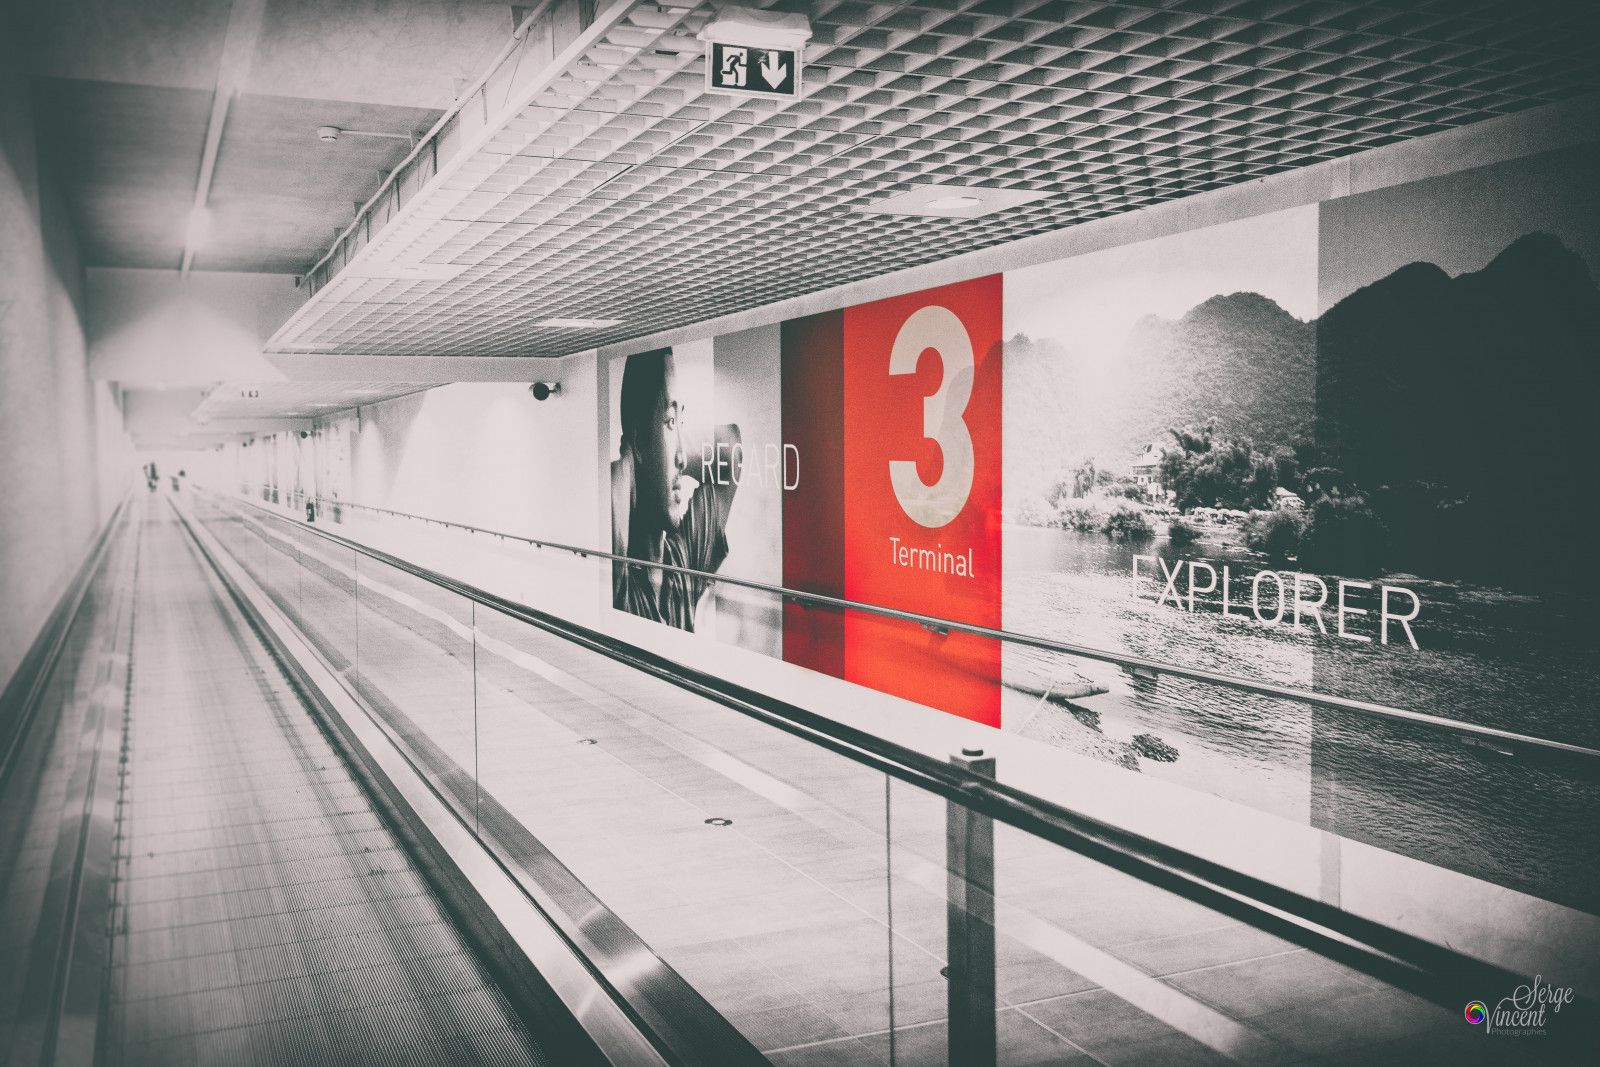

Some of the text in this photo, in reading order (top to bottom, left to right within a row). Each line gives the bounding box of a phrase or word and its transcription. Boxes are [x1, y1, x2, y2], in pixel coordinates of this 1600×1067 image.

[889, 305, 975, 529] 3
[701, 442, 800, 490] REGARD
[889, 537, 975, 578] Terminal
[1132, 554, 1420, 651] EXPLORER
